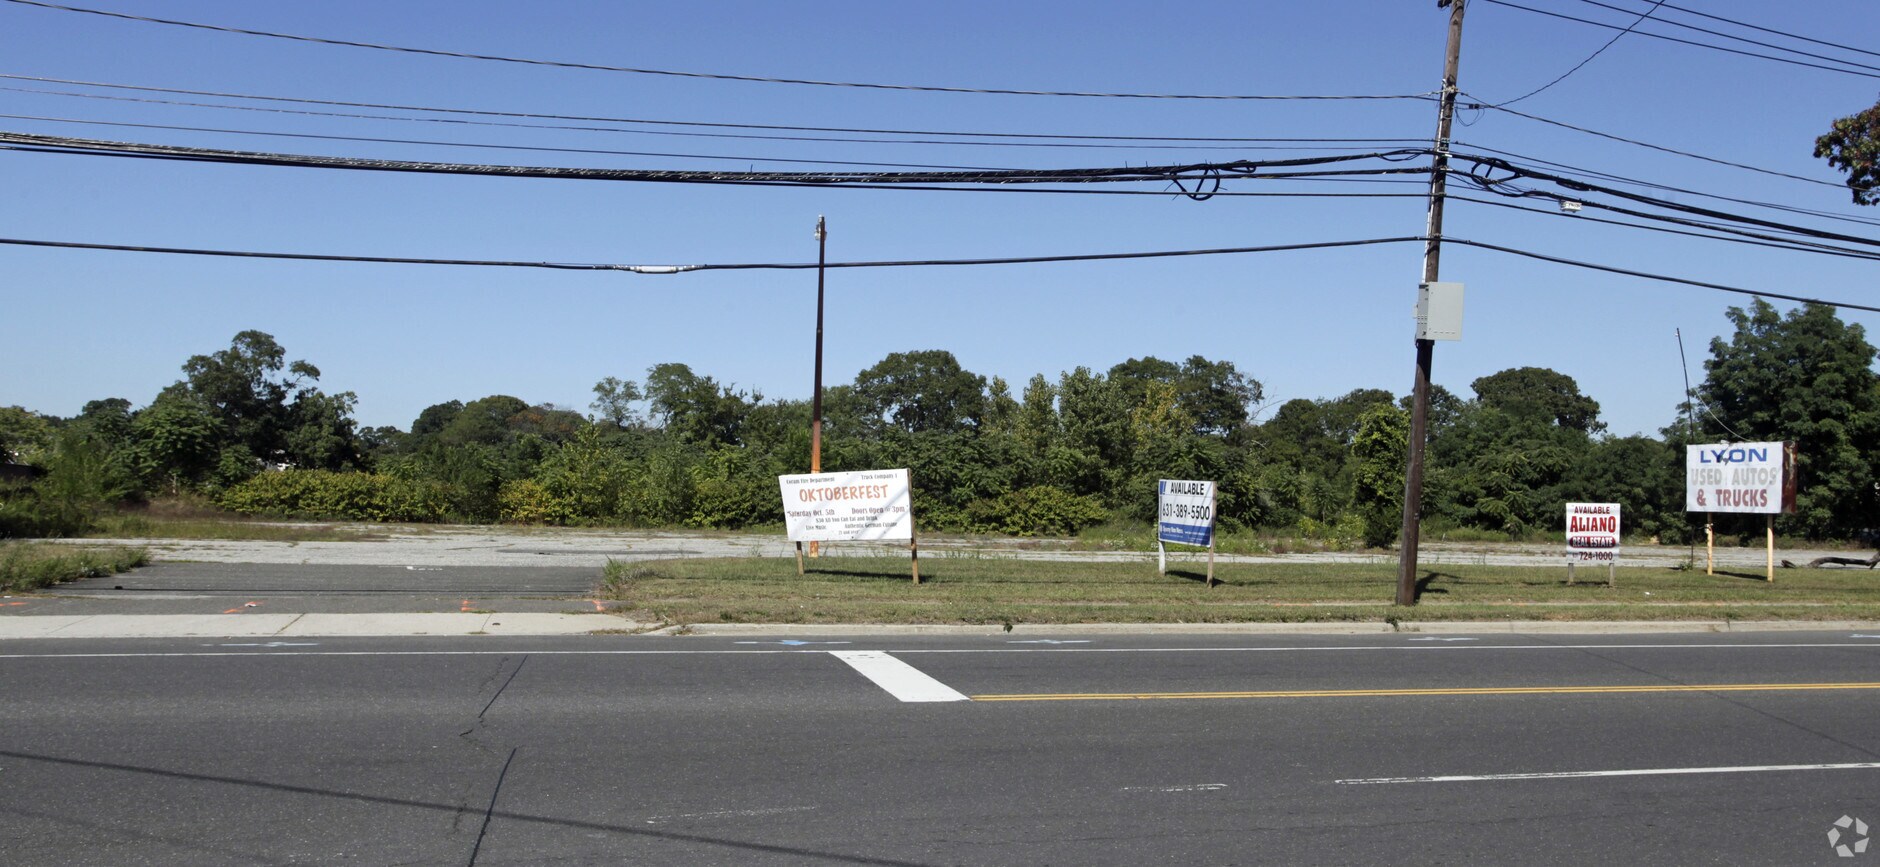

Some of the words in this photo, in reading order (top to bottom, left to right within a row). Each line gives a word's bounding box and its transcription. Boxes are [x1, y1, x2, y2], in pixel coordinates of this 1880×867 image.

[1700, 448, 1767, 464] LYON
[1691, 468, 1722, 485] USED
[1731, 467, 1777, 485] AUTOS
[799, 484, 888, 503] OKTOBERFEST
[1170, 482, 1205, 496] AVAILABLE
[1696, 488, 1707, 506] &
[1716, 488, 1768, 507] TRUCKS
[788, 510, 812, 518] Saturday
[851, 507, 868, 515] Doors
[869, 506, 884, 515] Open
[891, 505, 906, 514] 3pm
[1162, 502, 1211, 520] 631-389-5500
[1574, 505, 1611, 515] AVAILABLE
[1570, 515, 1616, 533] ALIANO
[1573, 537, 1589, 547] REAL
[1590, 537, 1613, 547] ESTATE
[1580, 551, 1613, 560] 724-1000
